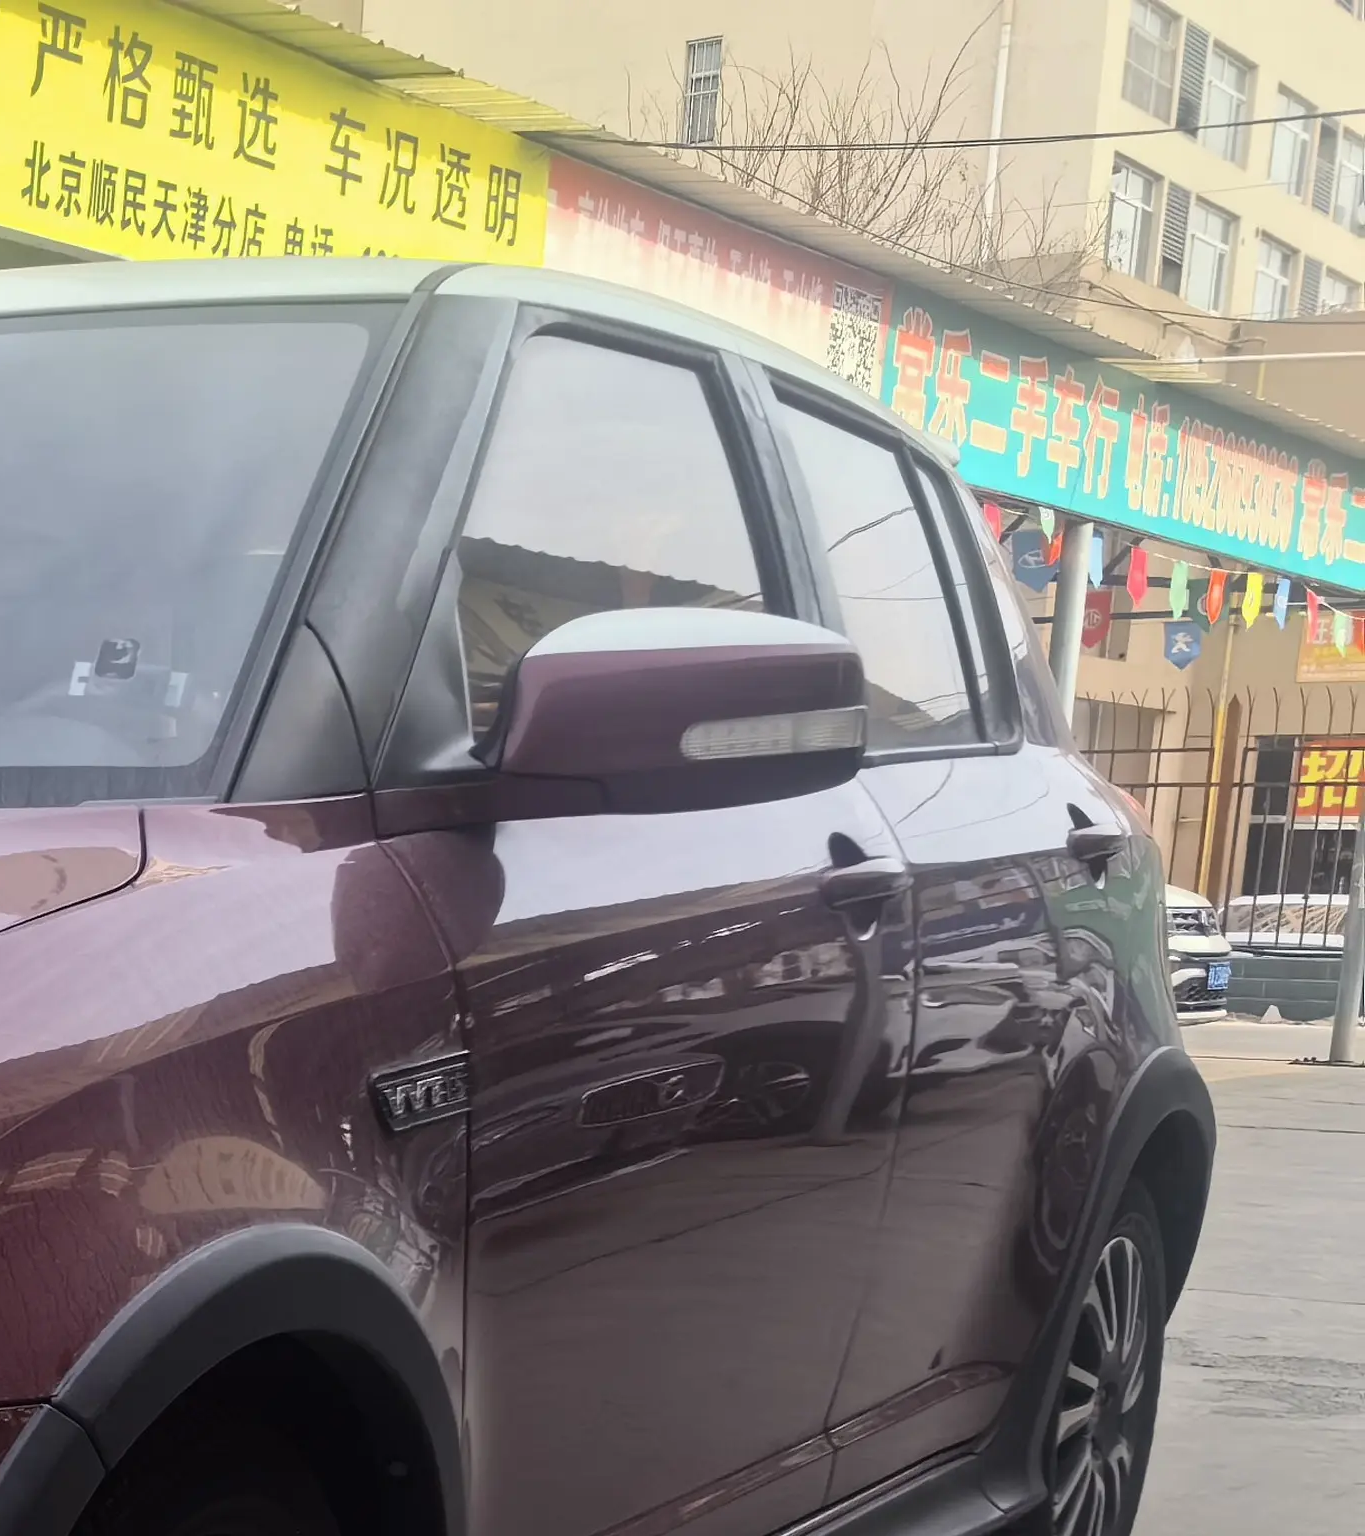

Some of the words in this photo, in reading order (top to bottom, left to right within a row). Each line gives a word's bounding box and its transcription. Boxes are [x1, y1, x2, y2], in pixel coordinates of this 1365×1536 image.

[30, 3, 281, 171] 严格甄选
[324, 107, 523, 248] 车况透明
[20, 140, 268, 258] 北京顺民天津分店
[1297, 745, 1362, 809] 招
